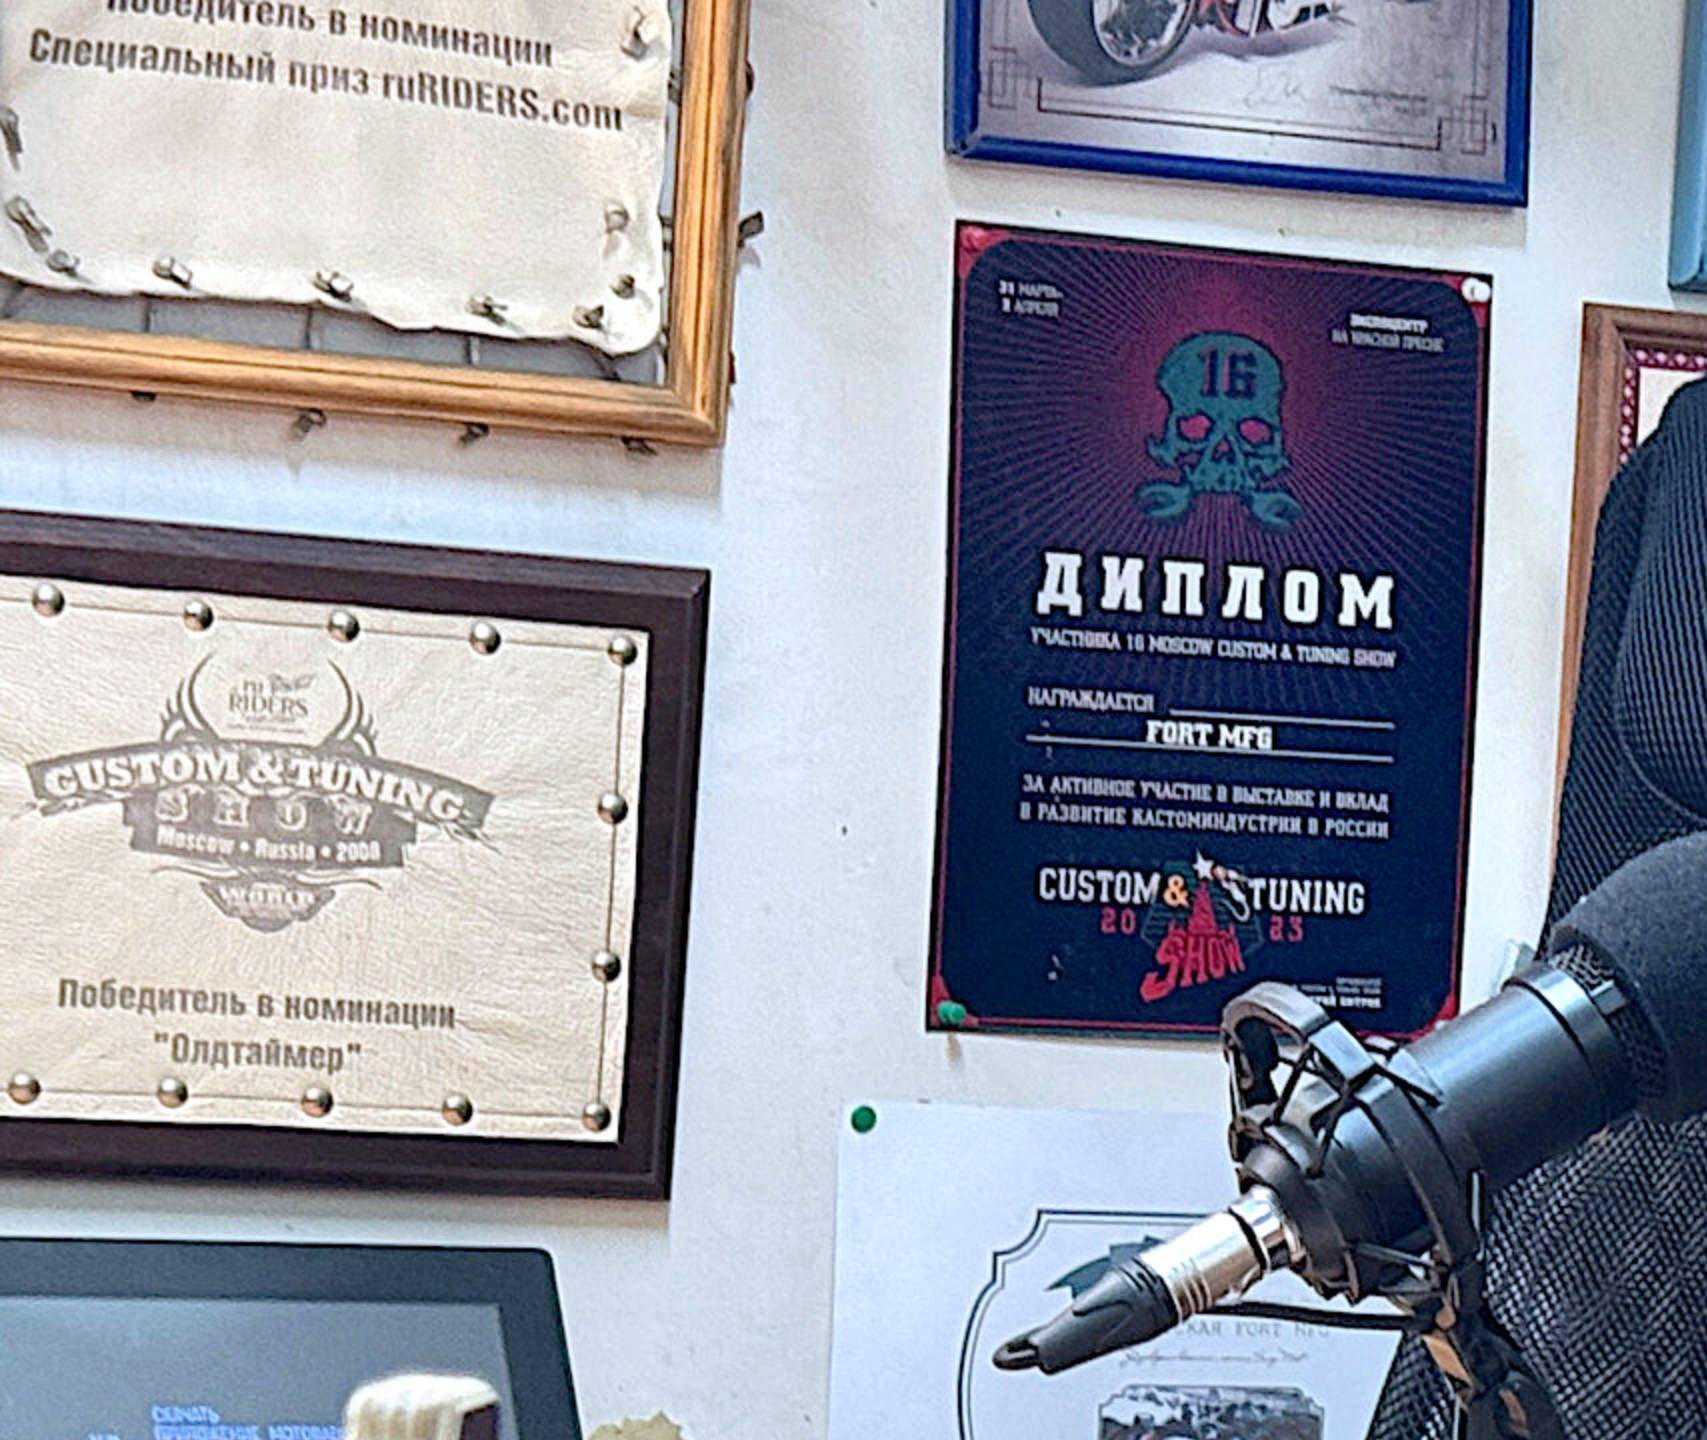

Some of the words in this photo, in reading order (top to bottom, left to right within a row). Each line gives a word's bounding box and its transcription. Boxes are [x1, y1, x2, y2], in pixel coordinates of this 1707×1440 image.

[328, 9, 347, 36] в
[360, 13, 552, 67] номинации
[30, 28, 275, 84] Специальный
[289, 61, 370, 94] приз
[382, 71, 623, 131] ruRIDERS.com
[1196, 348, 1257, 400] 16
[1035, 549, 1395, 630] ДИПЛОМ
[1148, 634, 1214, 656] MOSCOW
[1217, 639, 1277, 661] CUSTOM
[1280, 643, 1293, 661] &
[1296, 644, 1350, 666] TUNING
[1354, 648, 1397, 669] SHOW
[1027, 685, 1155, 713] НАГРАЖДАЕТСЯ
[1146, 719, 1214, 747] FORT
[1218, 723, 1273, 751] MFG
[44, 746, 241, 798] CUSTOM
[248, 750, 285, 785] &
[289, 757, 465, 822] TUNING
[1022, 773, 1045, 794] ЗА
[1050, 775, 1136, 798] АКТИВНОЕ
[1140, 780, 1212, 803] УЧАСТИЕ
[1232, 785, 1316, 808] ВЫСТАВКЕ
[1319, 790, 1331, 809] И
[1335, 791, 1390, 814] ВКЛАД
[156, 823, 236, 855] Moscow
[255, 837, 317, 861] Russia
[1038, 802, 1127, 825] РАЗВИТИЕ
[1132, 807, 1303, 835] КАСТОМИНДУСТРИИ
[1325, 818, 1390, 840] РОССИИ
[1039, 867, 1161, 905] CUSTOM
[1163, 873, 1190, 908] &
[1248, 876, 1366, 915] TUNING
[1140, 920, 1247, 1004] SHOW
[57, 977, 248, 1017] Победитель
[257, 992, 276, 1018] в
[284, 995, 456, 1029] номинации
[153, 1032, 363, 1075] "Олдтаймер"
